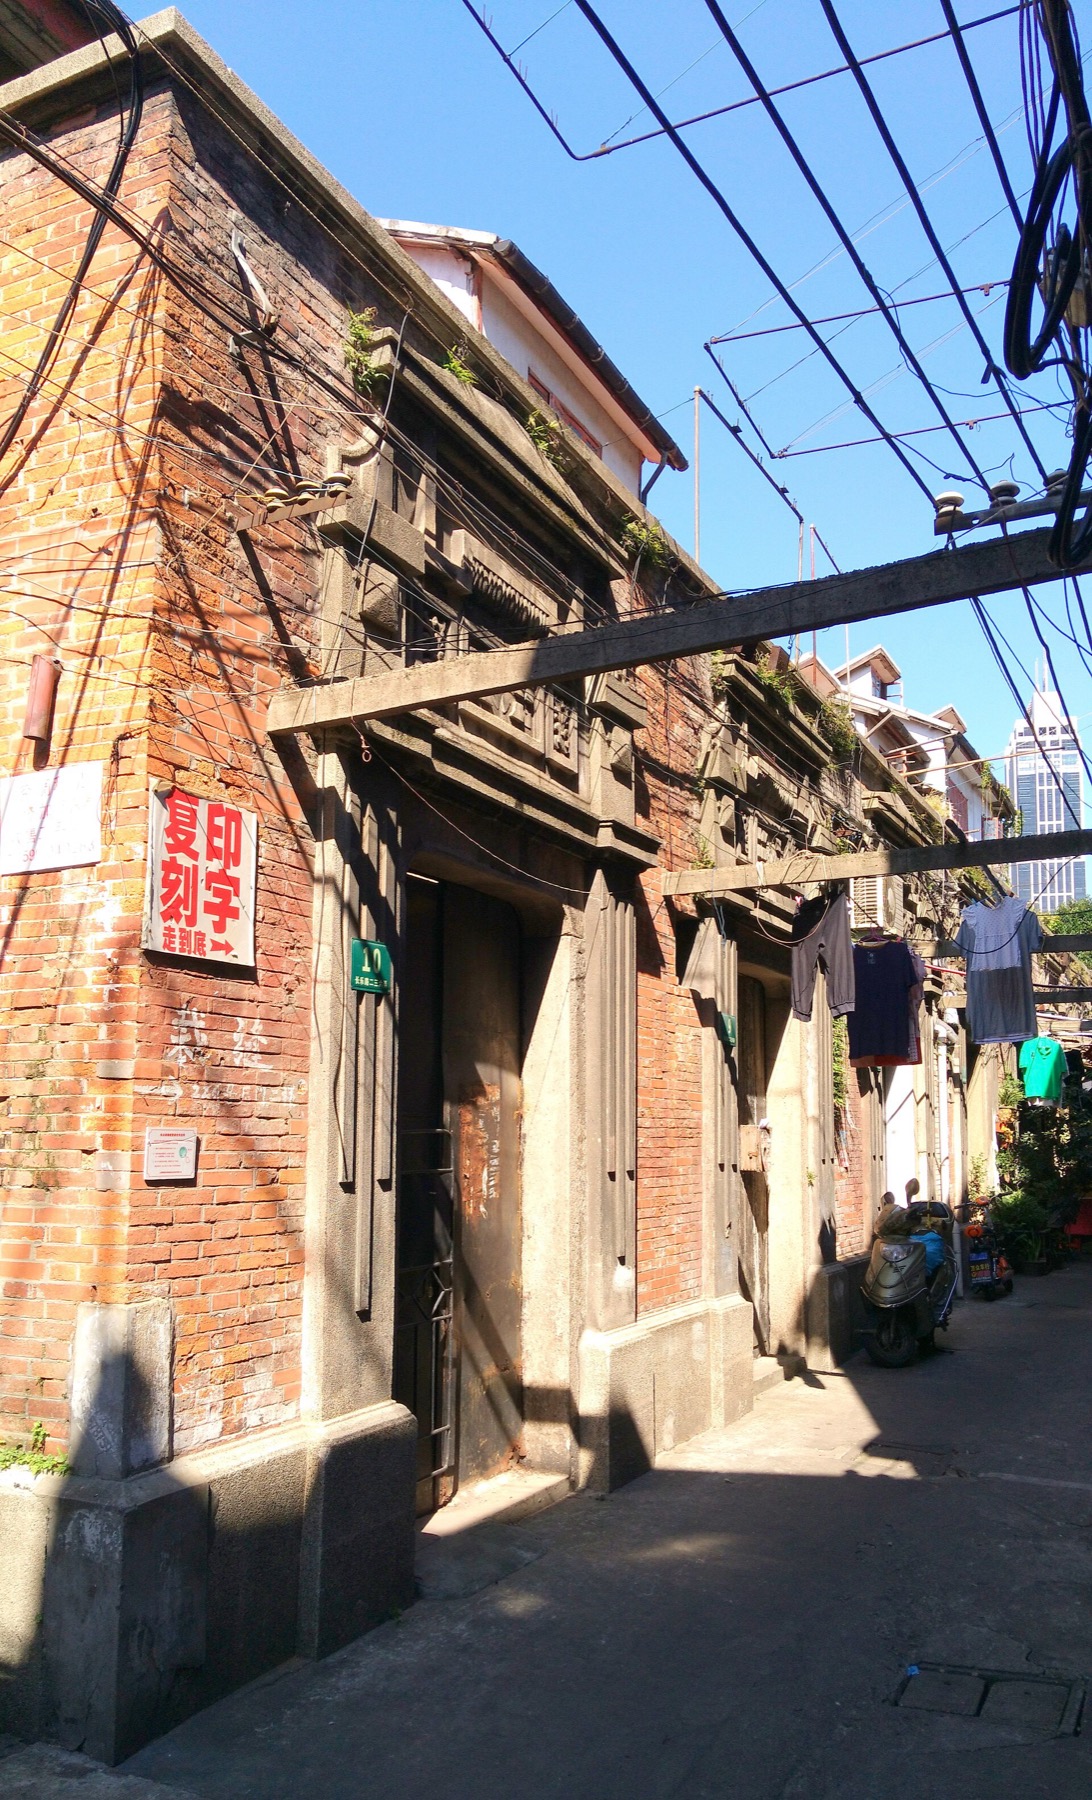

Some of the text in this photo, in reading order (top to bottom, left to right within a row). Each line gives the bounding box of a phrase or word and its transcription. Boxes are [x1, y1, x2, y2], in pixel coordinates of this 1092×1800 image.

[164, 788, 242, 870] 复印
[159, 856, 240, 934] 刻字
[163, 925, 206, 957] 走到底
[361, 946, 382, 973] 10
